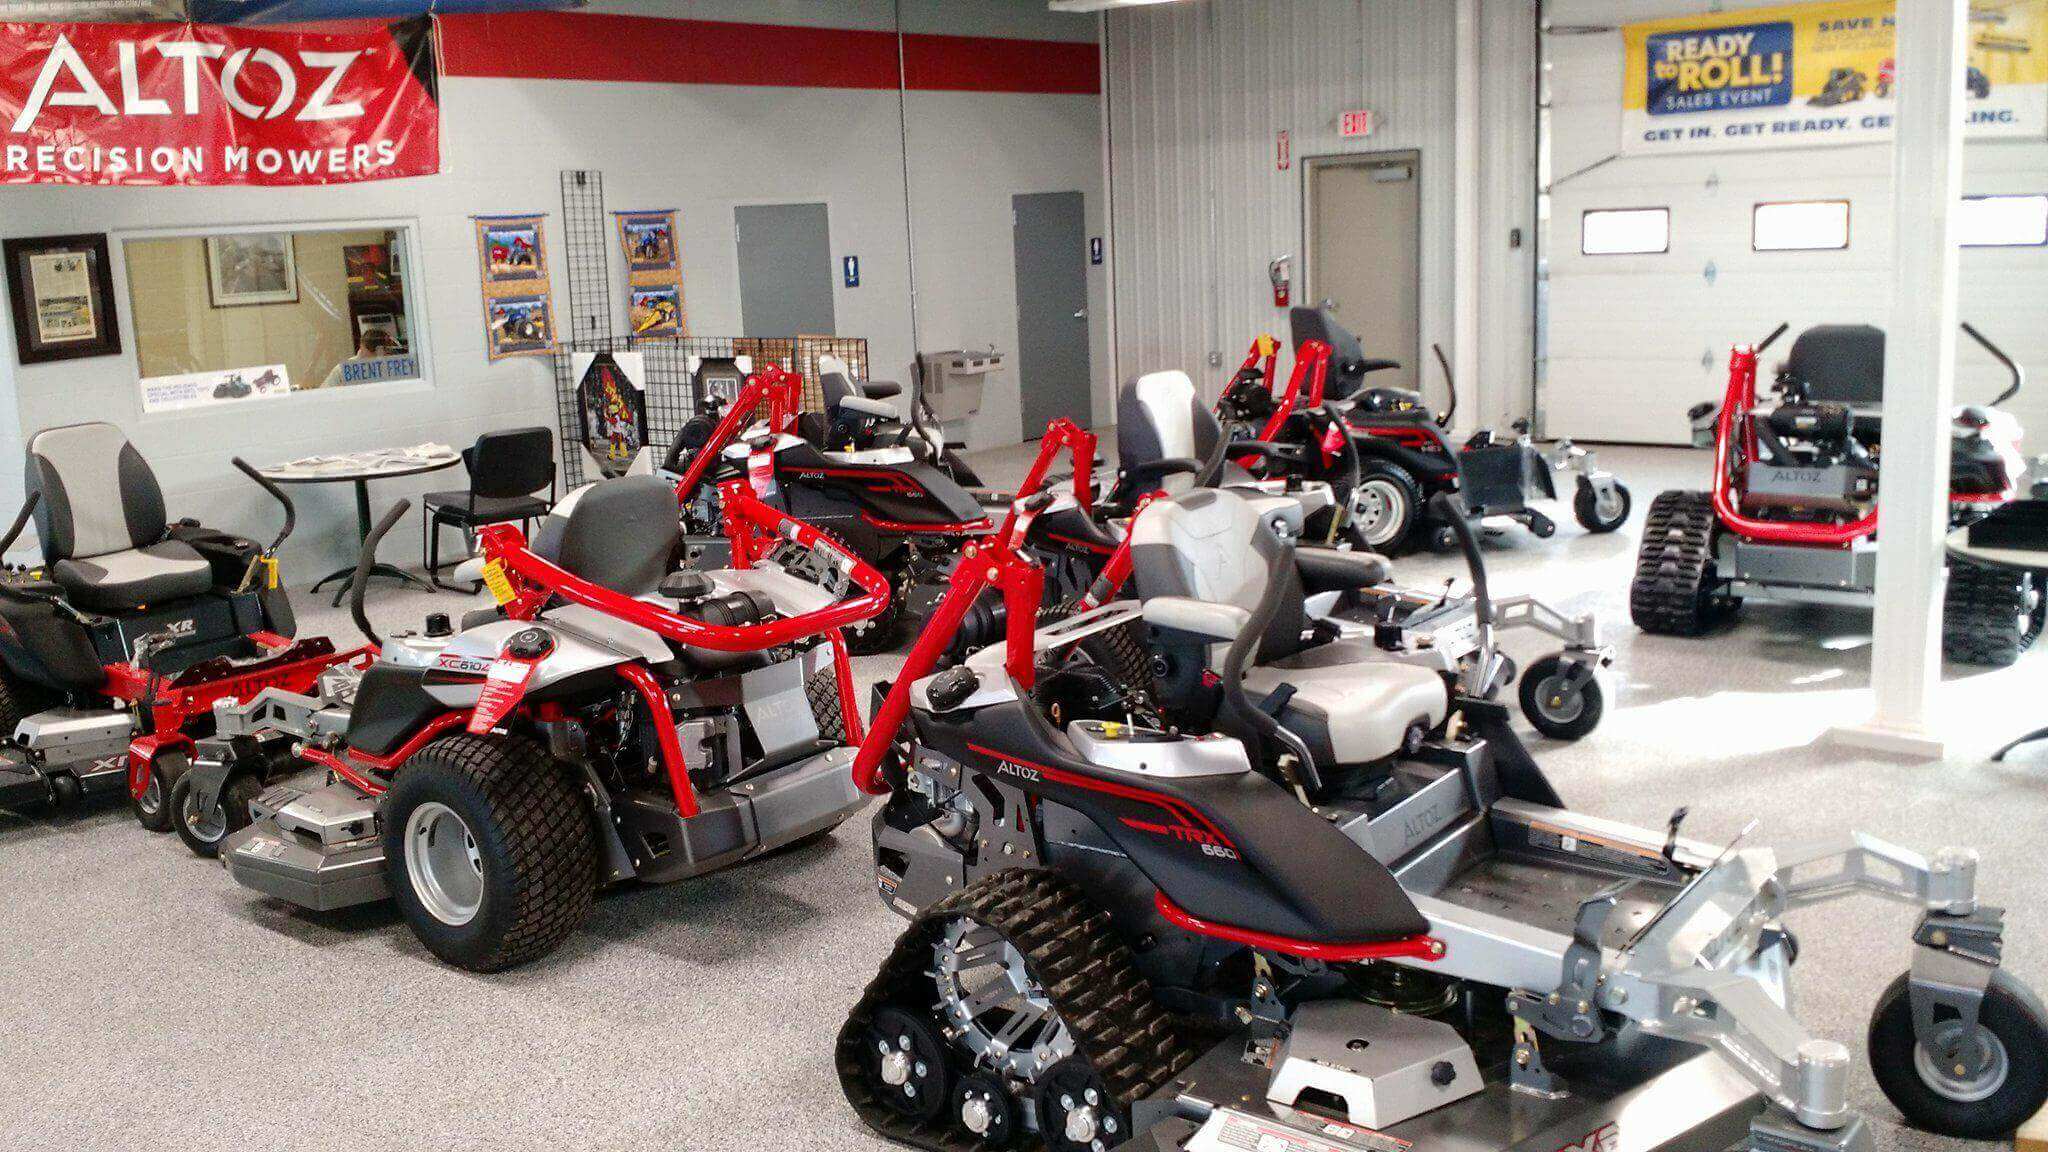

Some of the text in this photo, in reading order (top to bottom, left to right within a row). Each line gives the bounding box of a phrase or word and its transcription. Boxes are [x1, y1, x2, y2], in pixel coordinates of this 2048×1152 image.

[1818, 18, 1874, 31] SAVE
[1665, 31, 1756, 62] READY
[10, 32, 367, 134] ALTOZ
[1654, 52, 1784, 92] to ROLL!
[1665, 88, 1773, 111] SALES EVENT
[1643, 128, 1684, 141] GET
[1724, 123, 1766, 136] GET
[1861, 115, 1893, 129] GE
[1965, 110, 2020, 123] ING.
[6, 140, 398, 175] RECISION MOWERS
[343, 358, 415, 382] BRENT FREY
[996, 760, 1040, 783] ALTOZ
